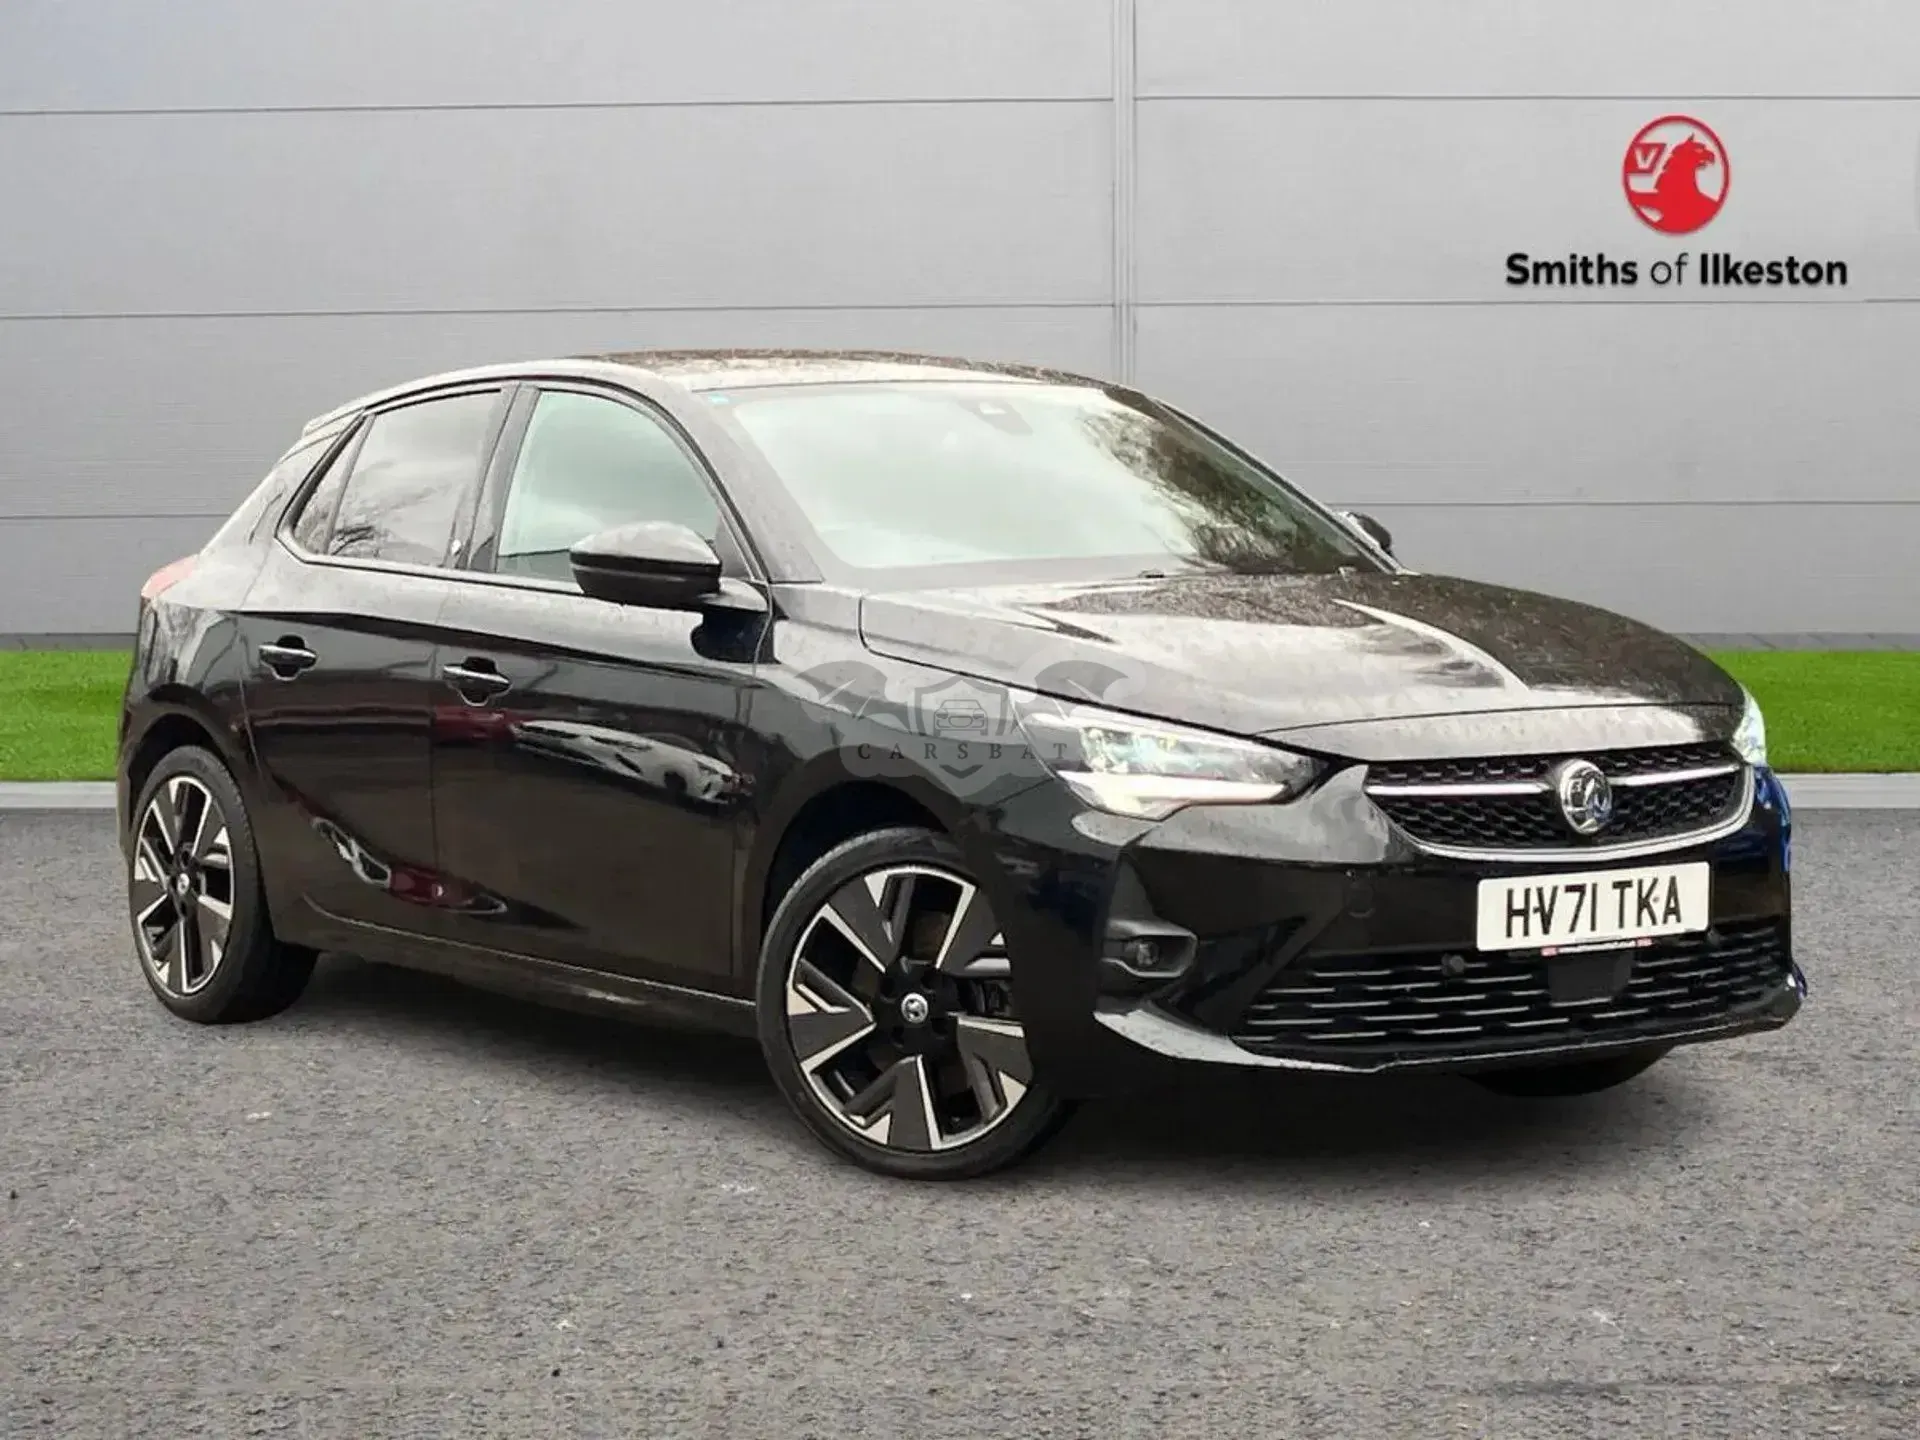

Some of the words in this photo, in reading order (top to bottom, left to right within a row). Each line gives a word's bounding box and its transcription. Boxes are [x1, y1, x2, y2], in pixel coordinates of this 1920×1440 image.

[1505, 253, 1638, 285] Smiths
[1650, 253, 1689, 285] of
[1700, 253, 1848, 285] Ilkeston
[1505, 882, 1598, 938] HV71
[1612, 875, 1682, 929] TKA
